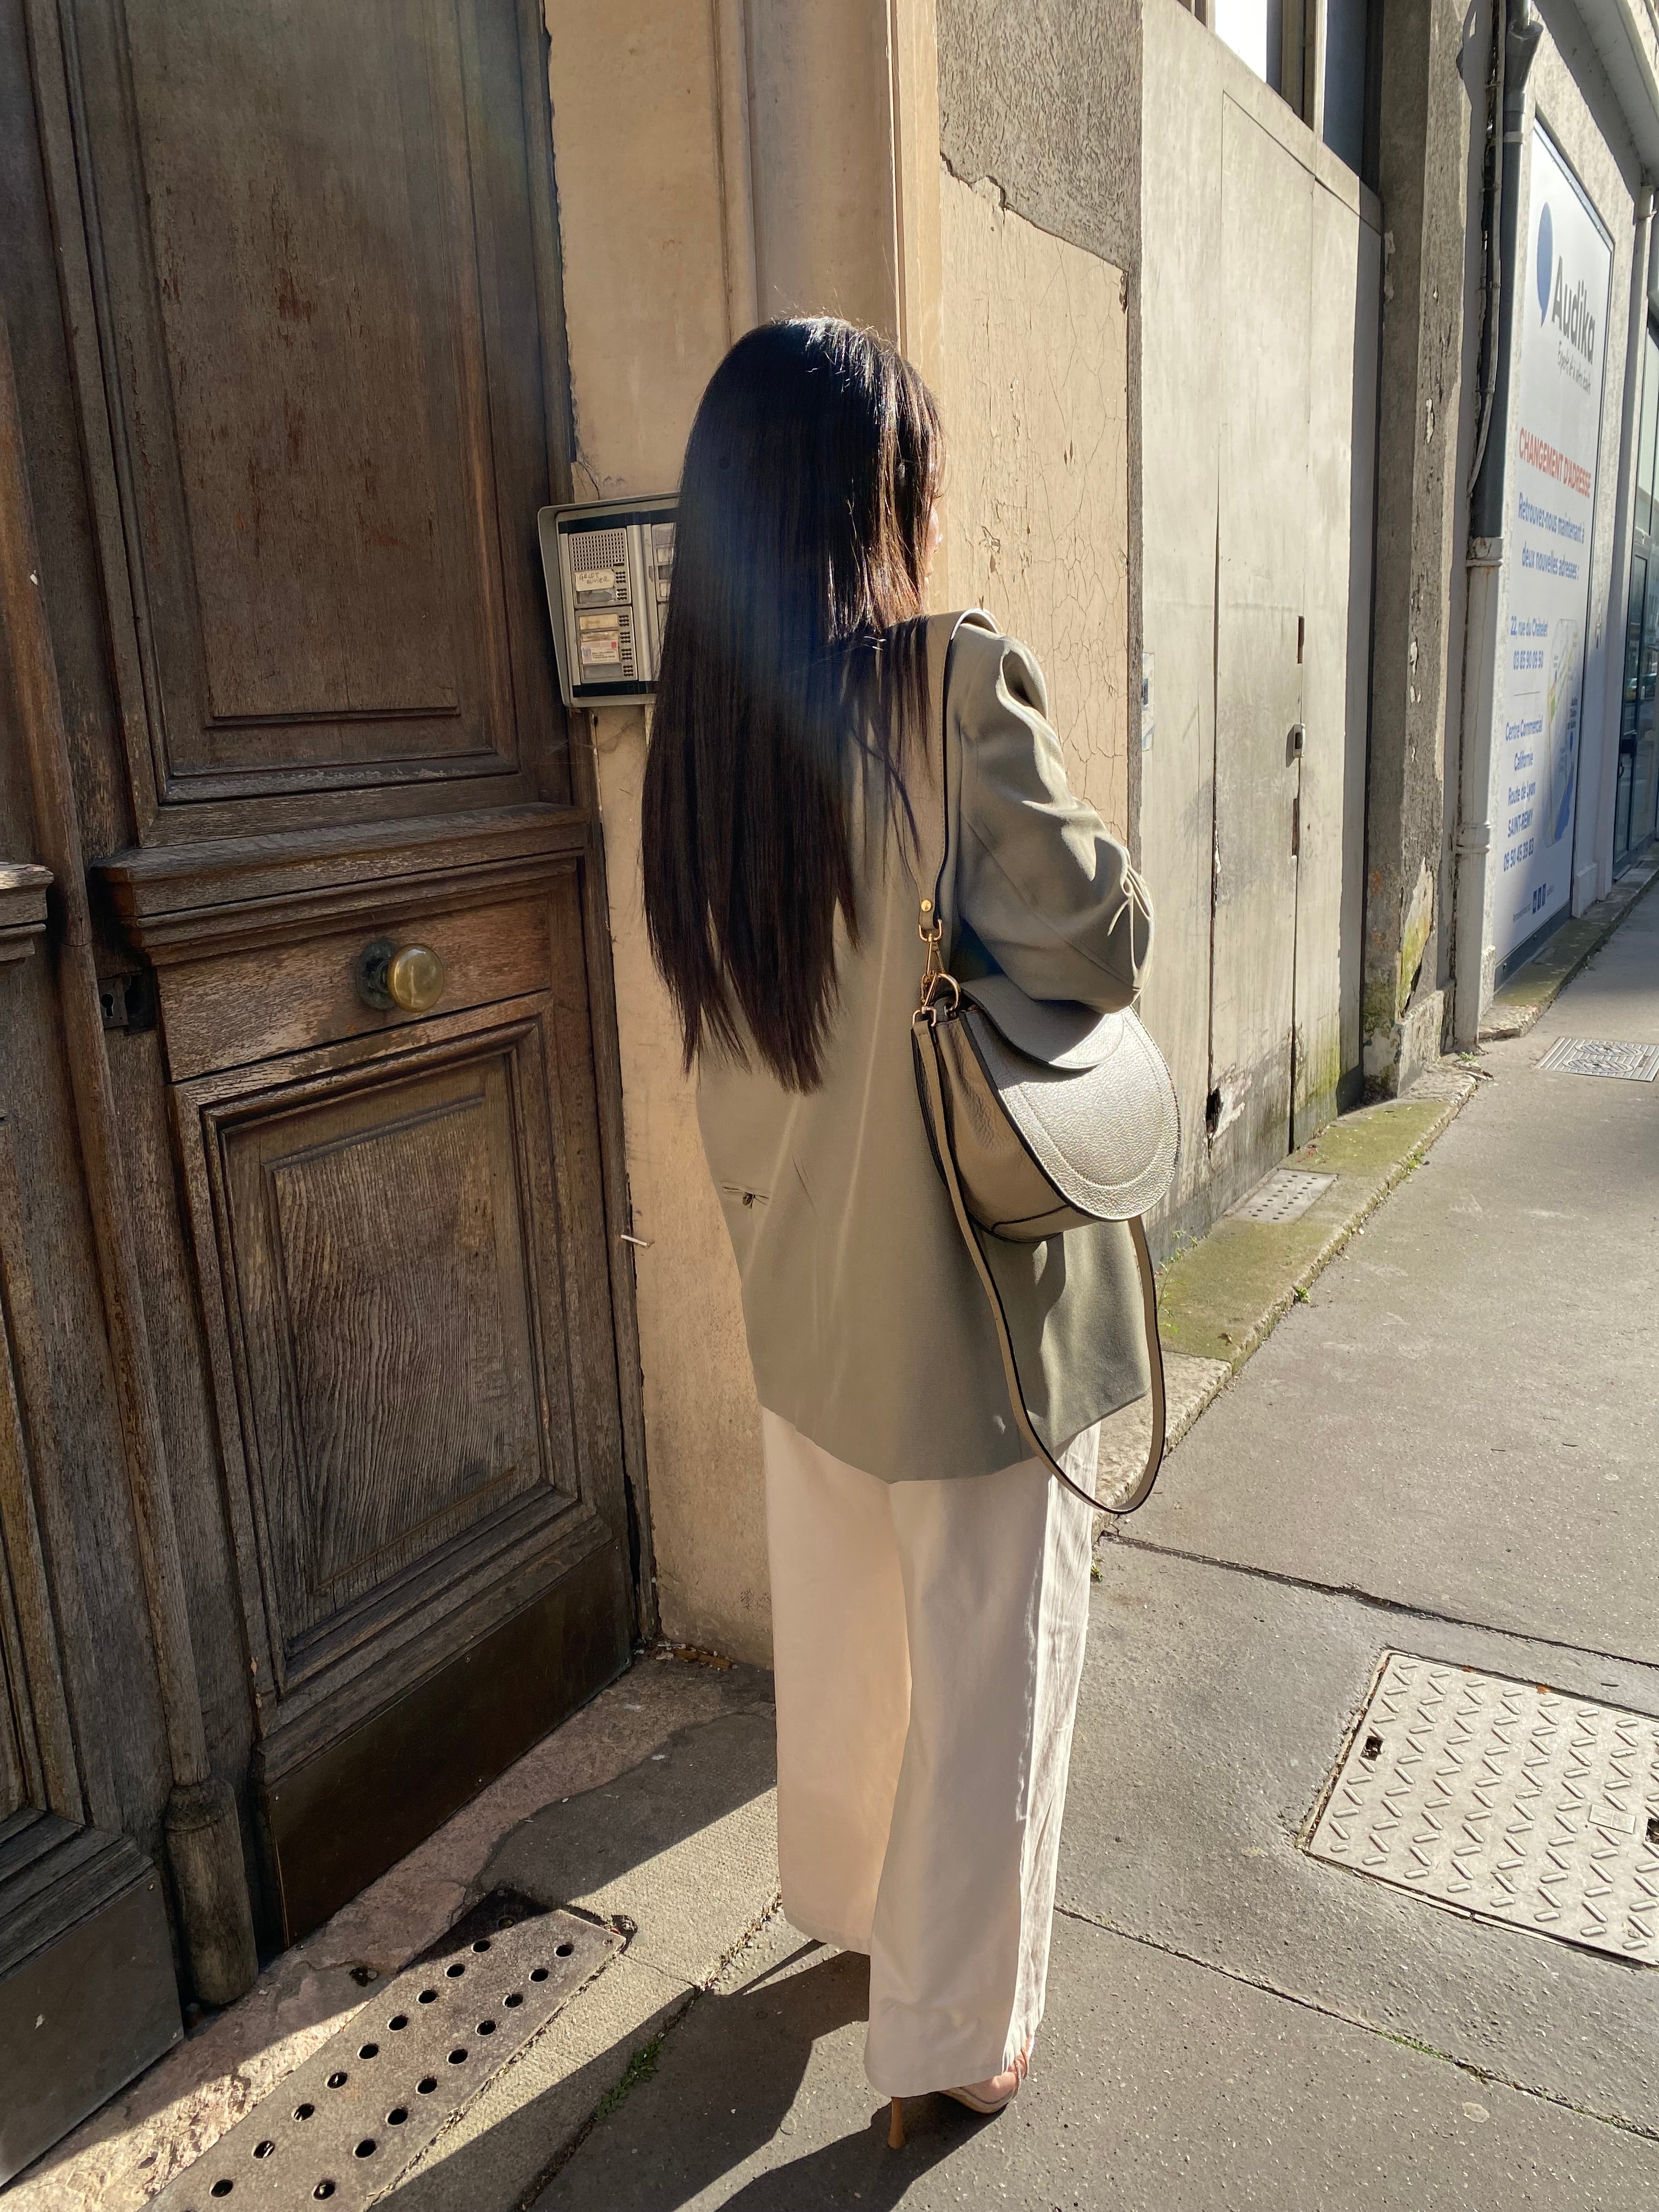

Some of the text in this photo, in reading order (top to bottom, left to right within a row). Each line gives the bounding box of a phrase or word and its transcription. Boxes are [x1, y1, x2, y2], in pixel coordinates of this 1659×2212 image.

[1551, 254, 1595, 365] Audika
[1519, 427, 1592, 498] CHANGEMENT D'ADRESSE
[1518, 492, 1557, 533] Retrouvez-nous
[1558, 511, 1582, 543] maintenant
[1522, 541, 1534, 568] deux
[1536, 550, 1558, 575] nouvelles
[1558, 554, 1577, 580] adresses
[1526, 617, 1532, 636] du
[1513, 650, 1519, 670] 03
[1505, 721, 1520, 741] Centre
[1520, 714, 1543, 738] Commercial
[1514, 747, 1533, 771] Californie
[1508, 786, 1520, 806] Route
[1521, 781, 1526, 800] de
